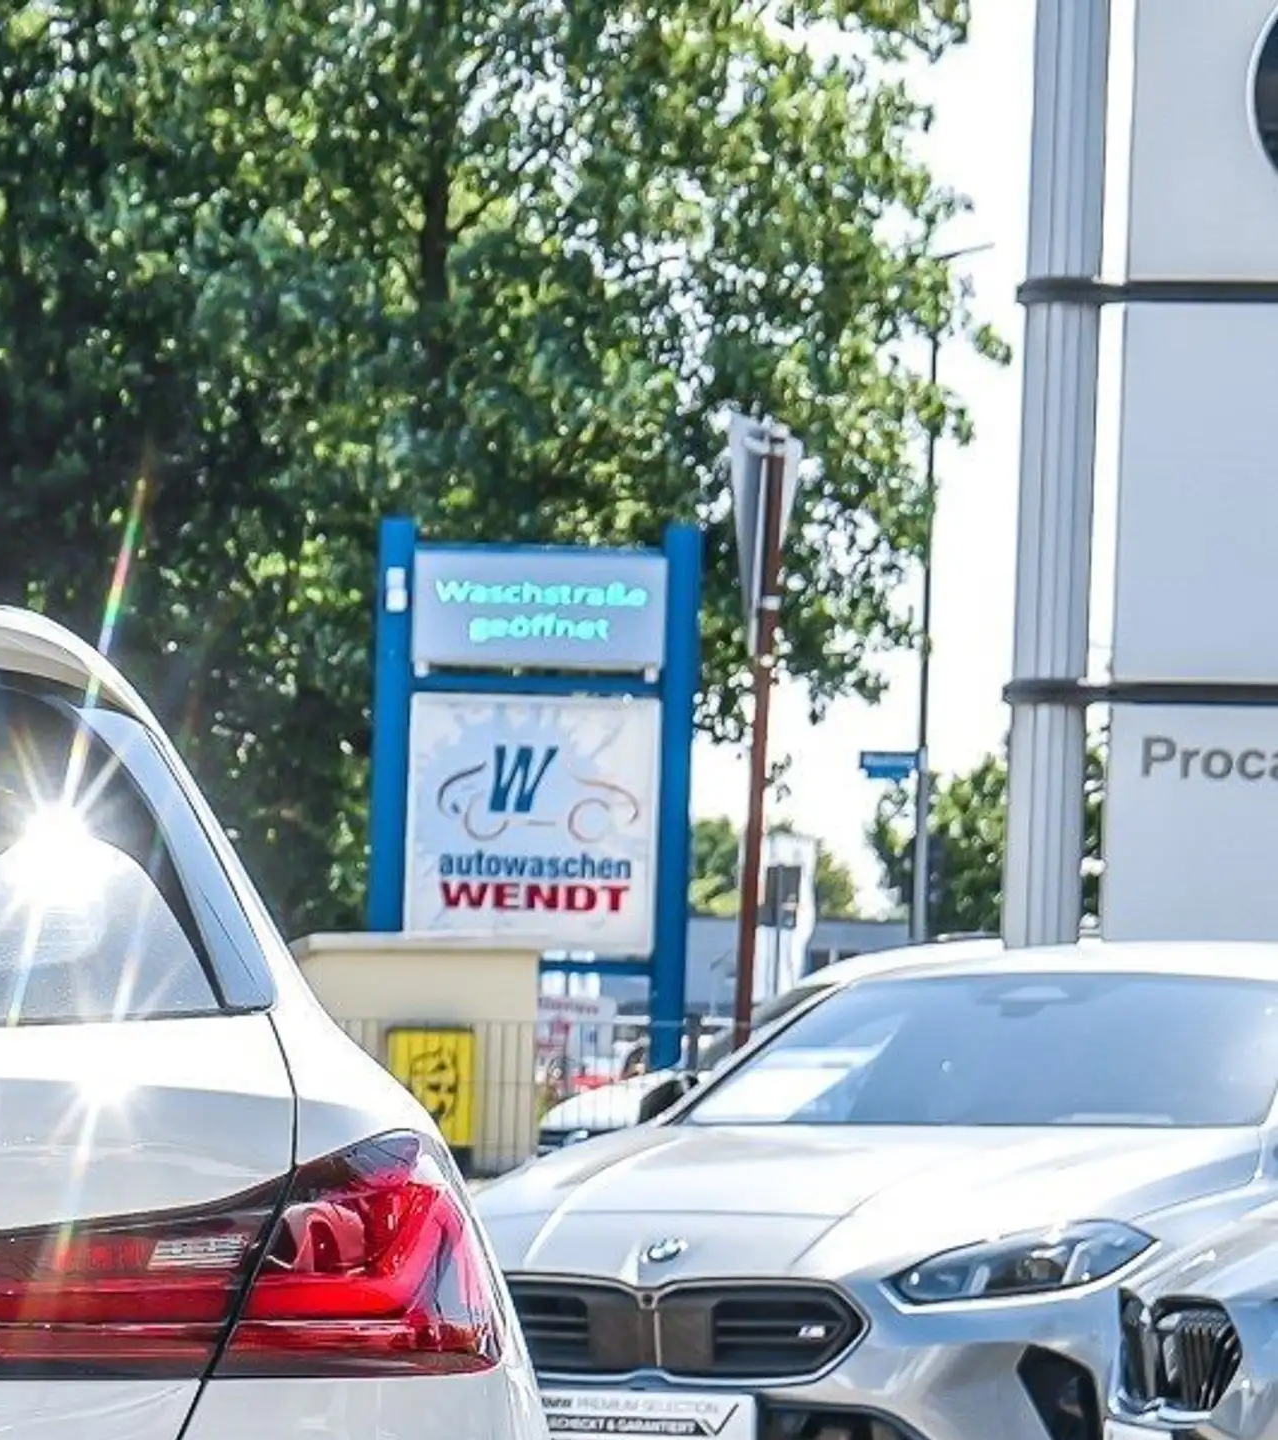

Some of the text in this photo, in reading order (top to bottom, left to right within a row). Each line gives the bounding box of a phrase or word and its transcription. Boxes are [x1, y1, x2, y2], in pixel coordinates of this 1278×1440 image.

[435, 579, 648, 607] Waschstraße
[468, 612, 610, 642] geöffnet
[488, 745, 559, 814] W
[439, 850, 633, 880] autowaschen
[441, 881, 631, 912] WENDT
